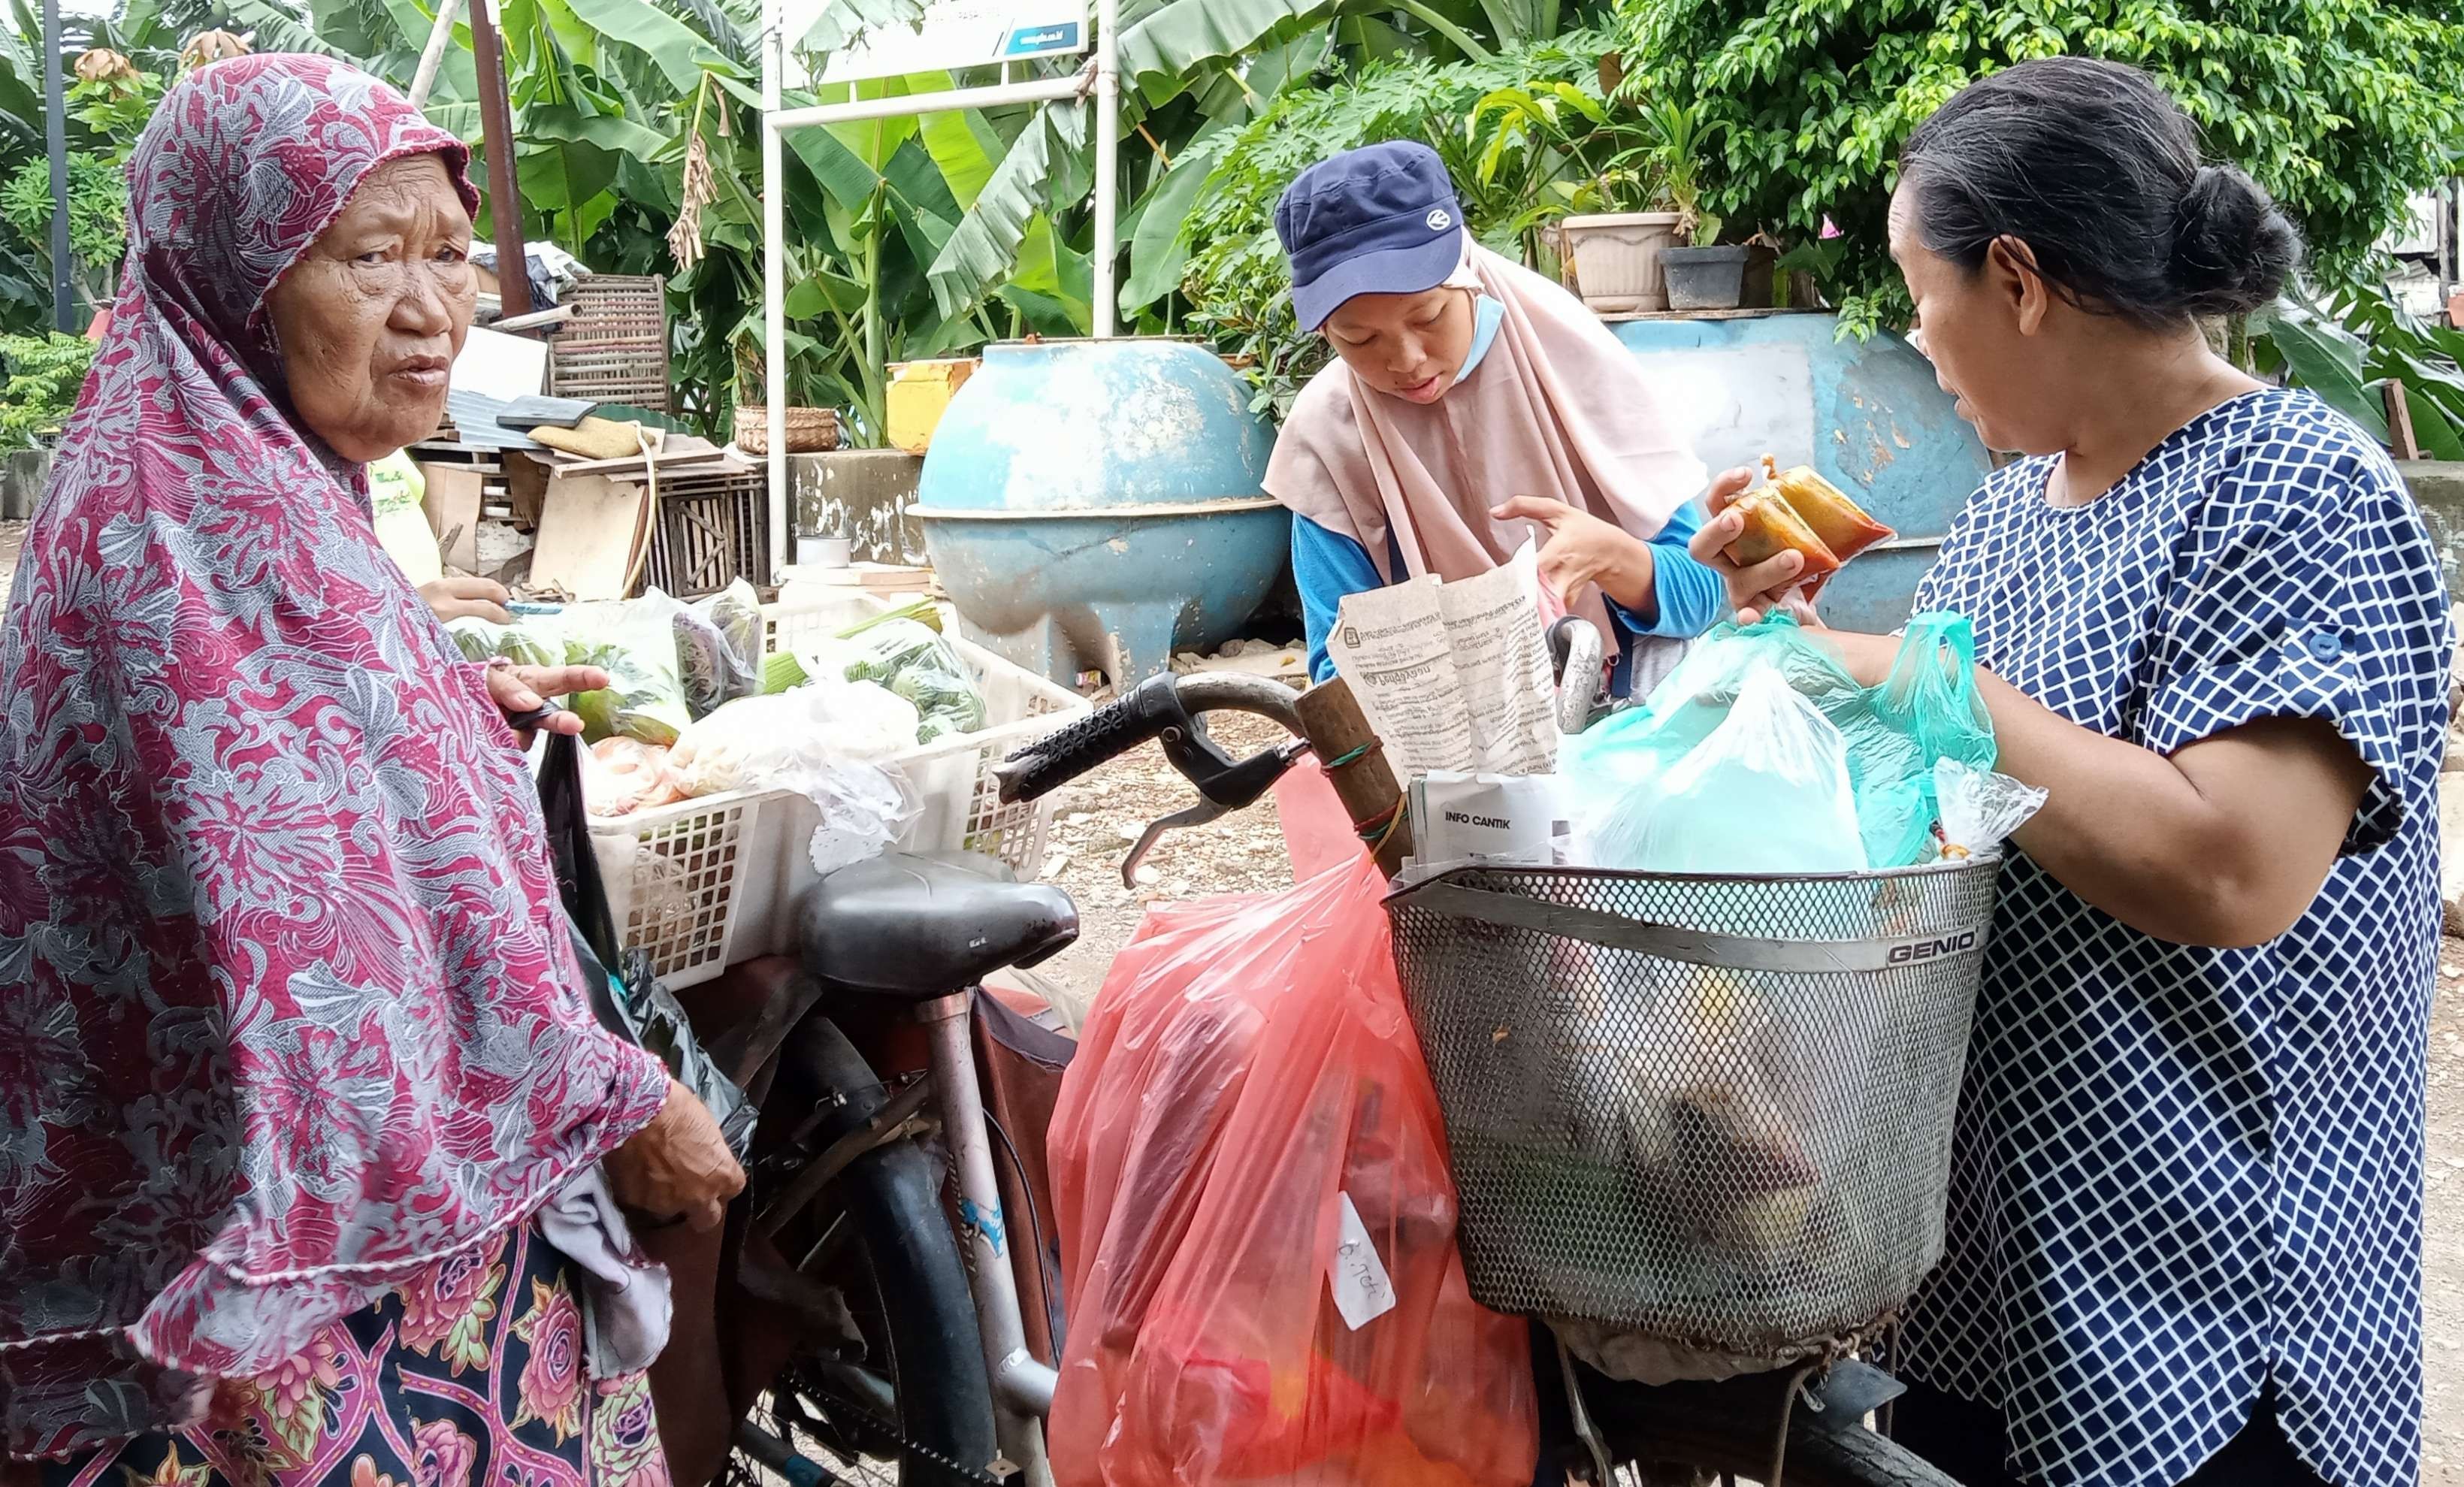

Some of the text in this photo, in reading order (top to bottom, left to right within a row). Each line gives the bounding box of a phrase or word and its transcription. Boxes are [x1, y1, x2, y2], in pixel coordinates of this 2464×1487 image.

[1445, 811, 1510, 830] INFO CANTIK
[1889, 931, 1975, 963] GENIO
